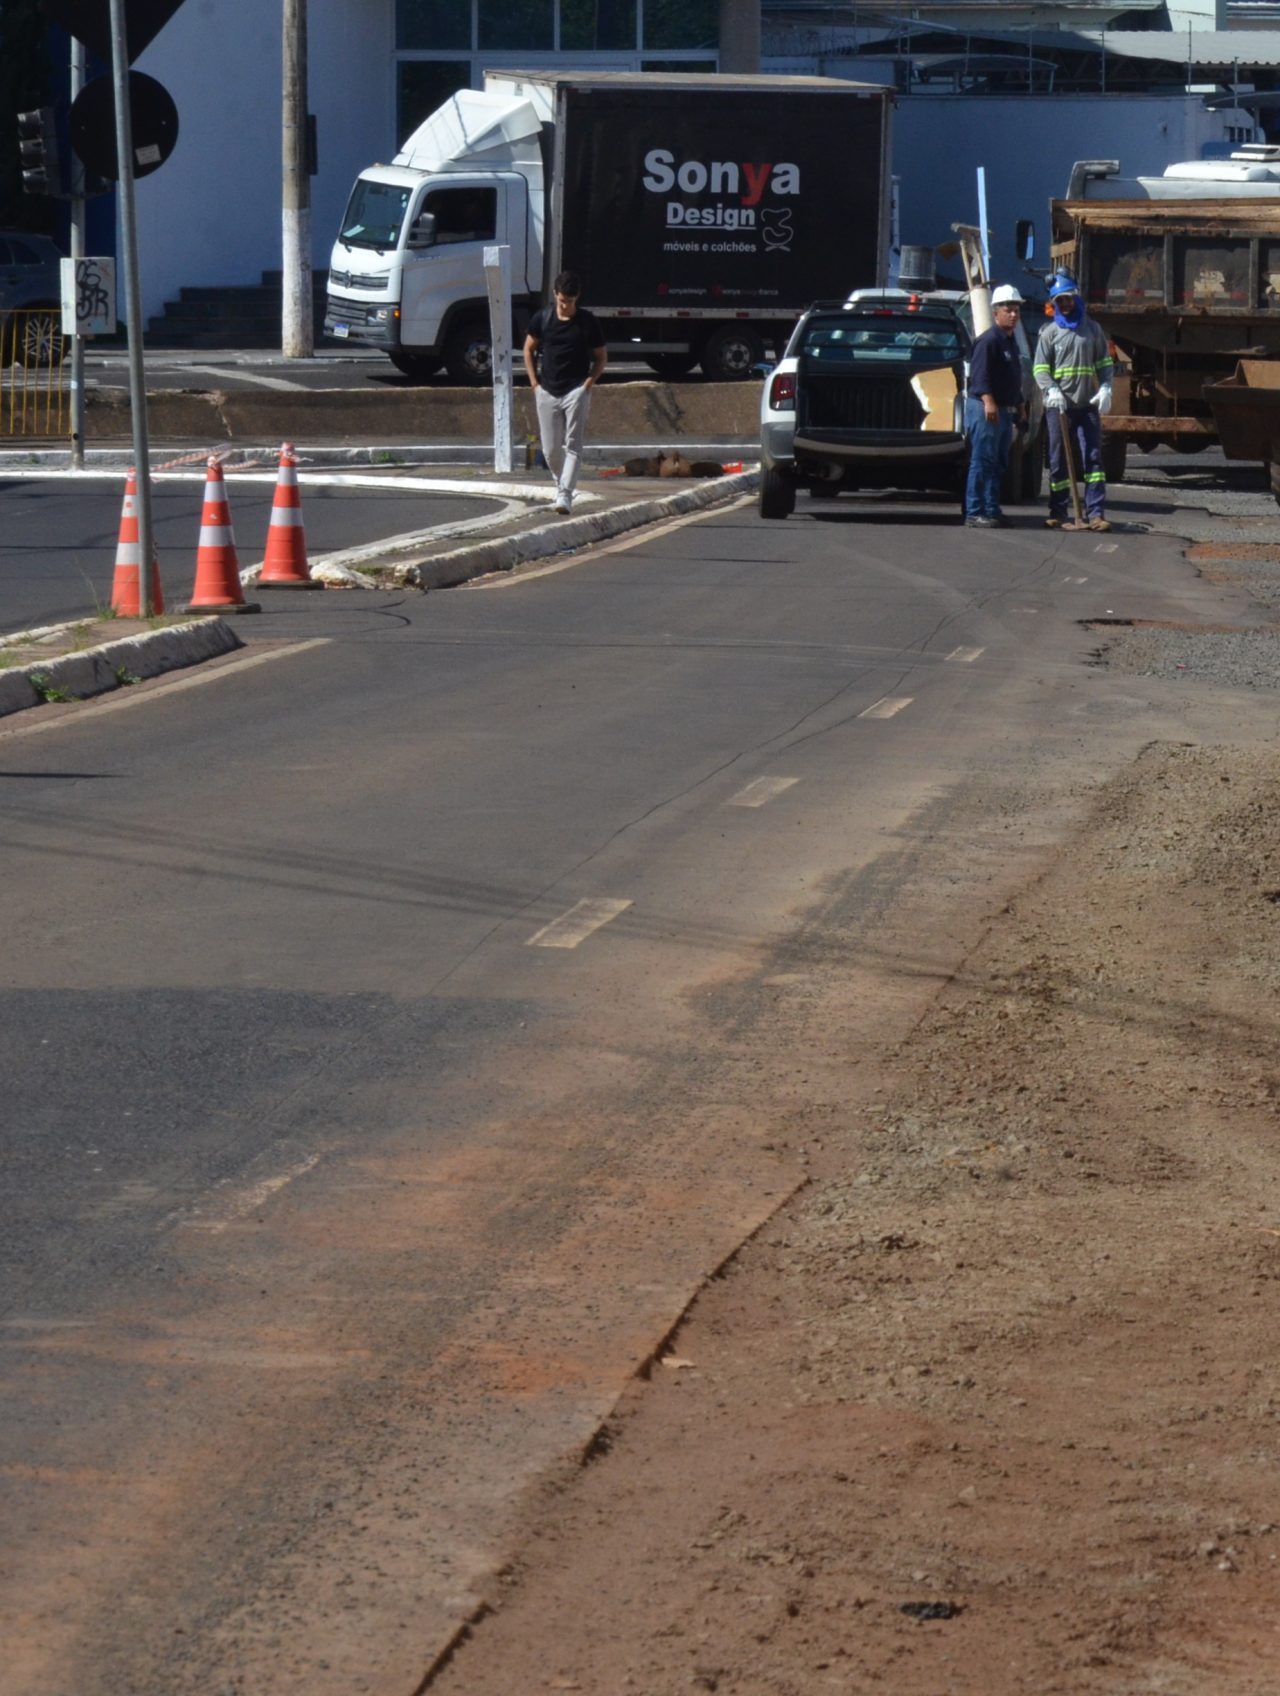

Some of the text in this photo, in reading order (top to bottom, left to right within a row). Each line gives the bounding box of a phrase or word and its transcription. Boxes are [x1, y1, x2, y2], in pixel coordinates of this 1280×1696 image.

[643, 149, 800, 205] Sonya
[666, 202, 756, 230] Design
[663, 241, 757, 252] móveis e colchões
